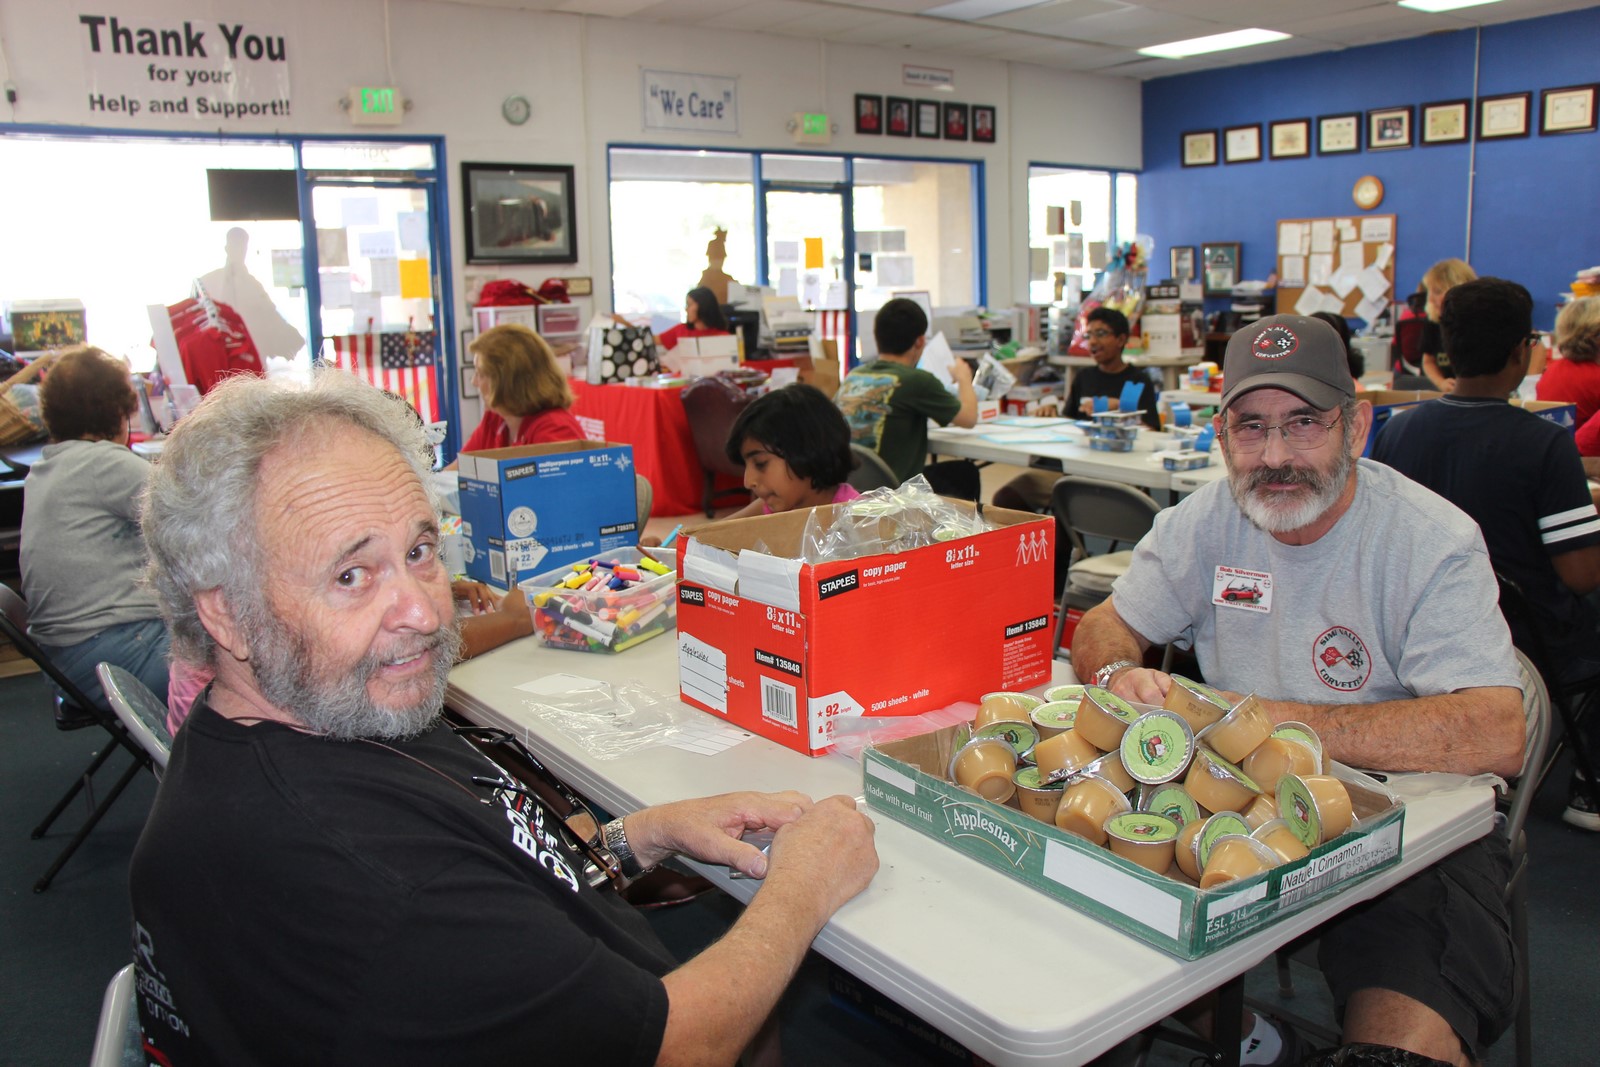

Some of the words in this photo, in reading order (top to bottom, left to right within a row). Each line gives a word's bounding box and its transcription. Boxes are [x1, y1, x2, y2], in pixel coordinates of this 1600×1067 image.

[79, 14, 208, 58] Thank
[218, 23, 285, 61] You
[148, 64, 178, 81] for
[186, 69, 232, 87] your
[89, 94, 141, 116] Help
[149, 97, 188, 114] and
[197, 98, 291, 119] Support!!
[361, 87, 393, 113] EXIT
[1267, 327, 1296, 340] VALLEY
[507, 465, 535, 479] STAPLES
[863, 566, 883, 577] copy
[885, 561, 907, 575] paper
[1235, 569, 1268, 579] Silverman
[821, 575, 856, 594] STAPLES
[680, 589, 703, 601] STAPLES
[707, 590, 720, 603] copy
[722, 595, 739, 607] paper
[1006, 624, 1023, 636] Item#
[1025, 617, 1046, 630] 135848
[1320, 629, 1338, 646] SIMI
[1339, 629, 1364, 652] VALLEY
[756, 651, 774, 665] Item#
[776, 658, 800, 673] 135848
[826, 703, 839, 717] 92
[871, 700, 887, 712] 5000
[888, 695, 908, 707] sheets
[913, 689, 930, 700] white
[866, 783, 883, 798] Made
[885, 793, 900, 807] with
[902, 801, 915, 814] real
[918, 808, 932, 822] fruit
[954, 809, 1018, 852] Applesnax
[1318, 843, 1363, 872] Cinnamon
[1206, 916, 1228, 934] Est.
[1206, 928, 1229, 942] Product
[1237, 916, 1259, 928] Canada
